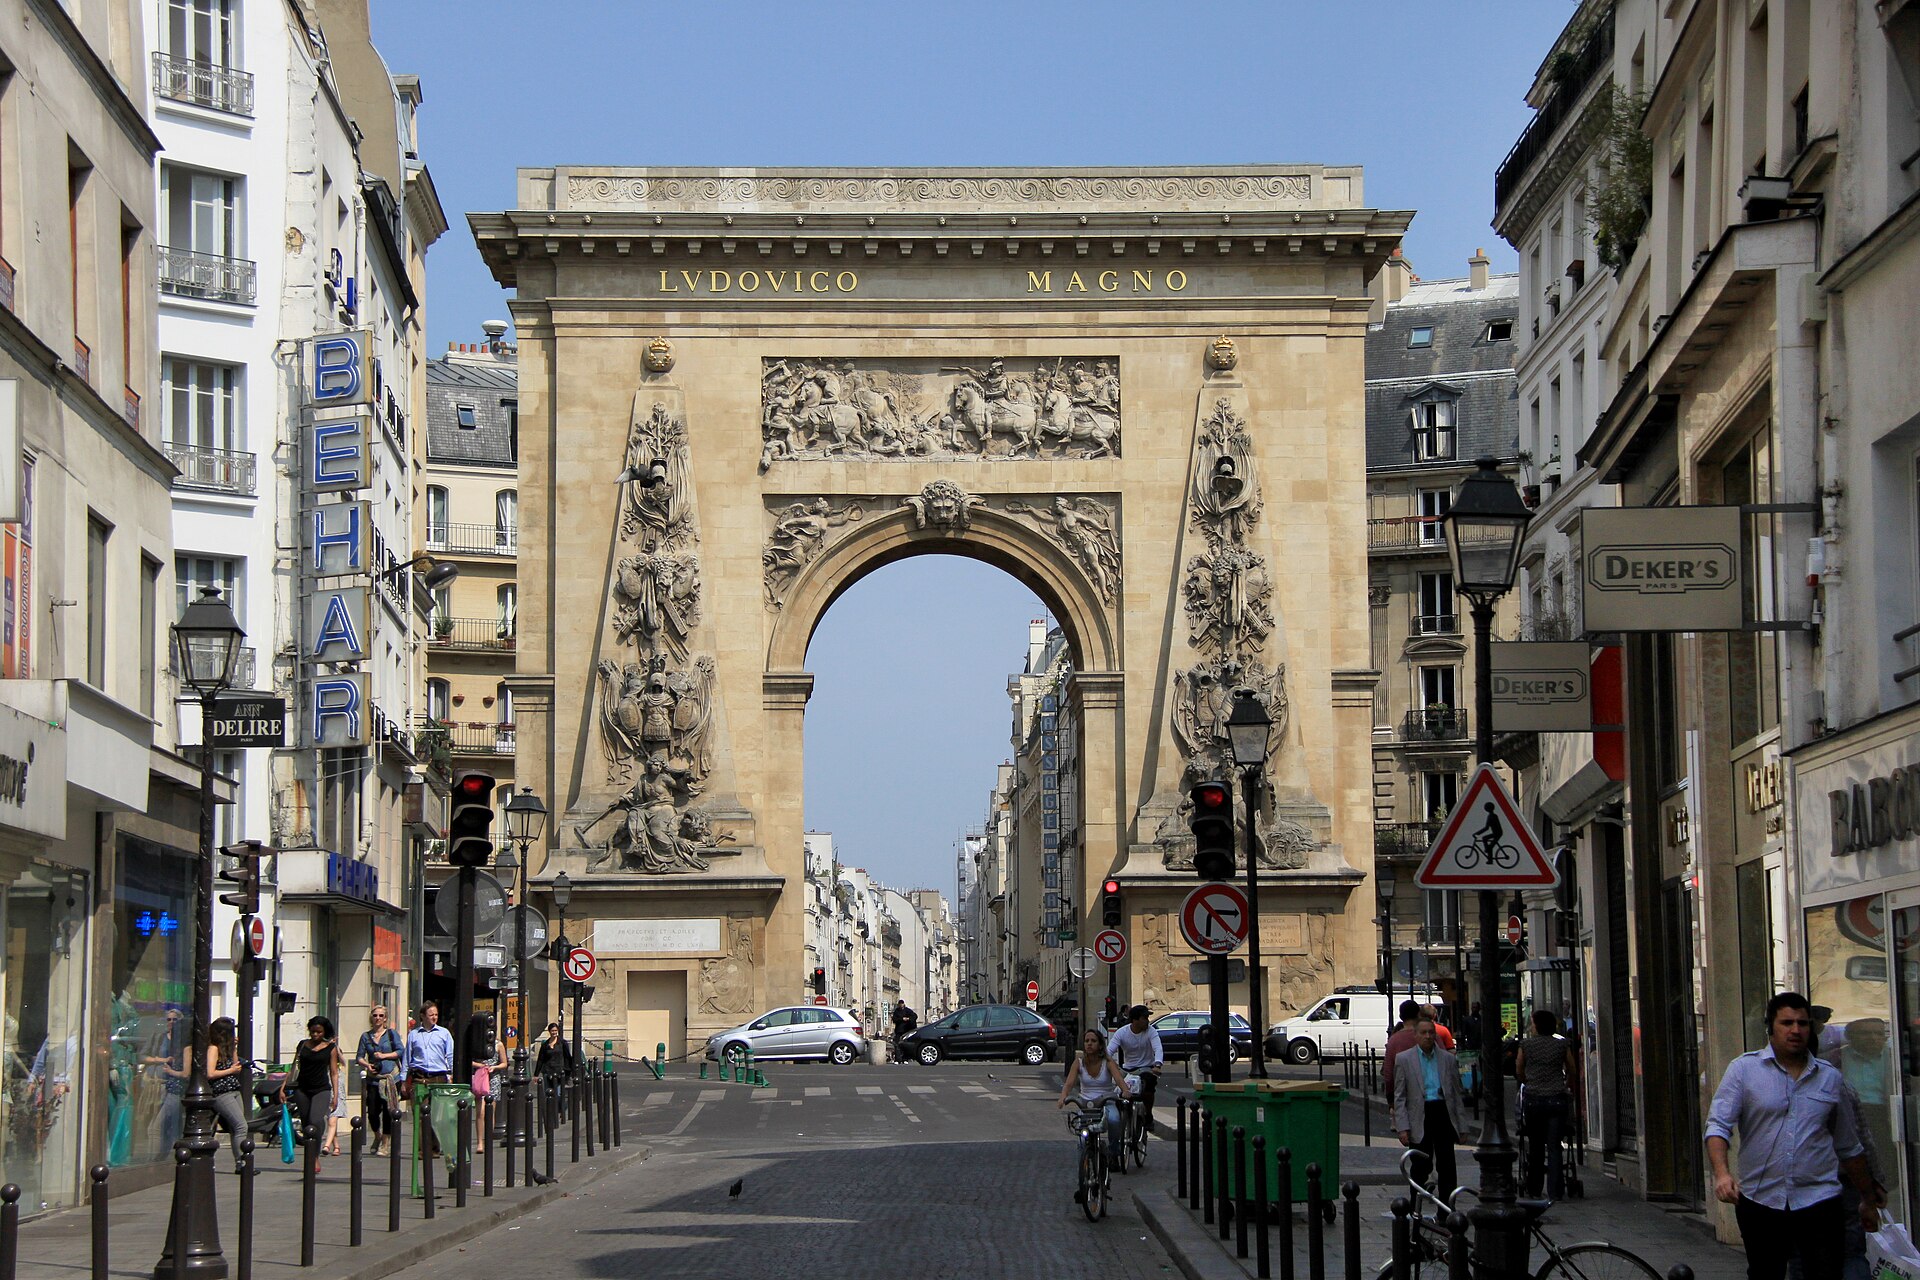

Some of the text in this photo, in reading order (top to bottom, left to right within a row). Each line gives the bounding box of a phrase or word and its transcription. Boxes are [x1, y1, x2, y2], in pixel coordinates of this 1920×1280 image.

[659, 269, 1188, 293] LVDOVICO MAGNO
[313, 337, 362, 741] BEHAR
[1605, 554, 1719, 580] DEKER'S
[1493, 676, 1575, 694] DEKER'S
[213, 720, 282, 736] DELIRE
[1877, 1257, 1912, 1280] MERLIN
